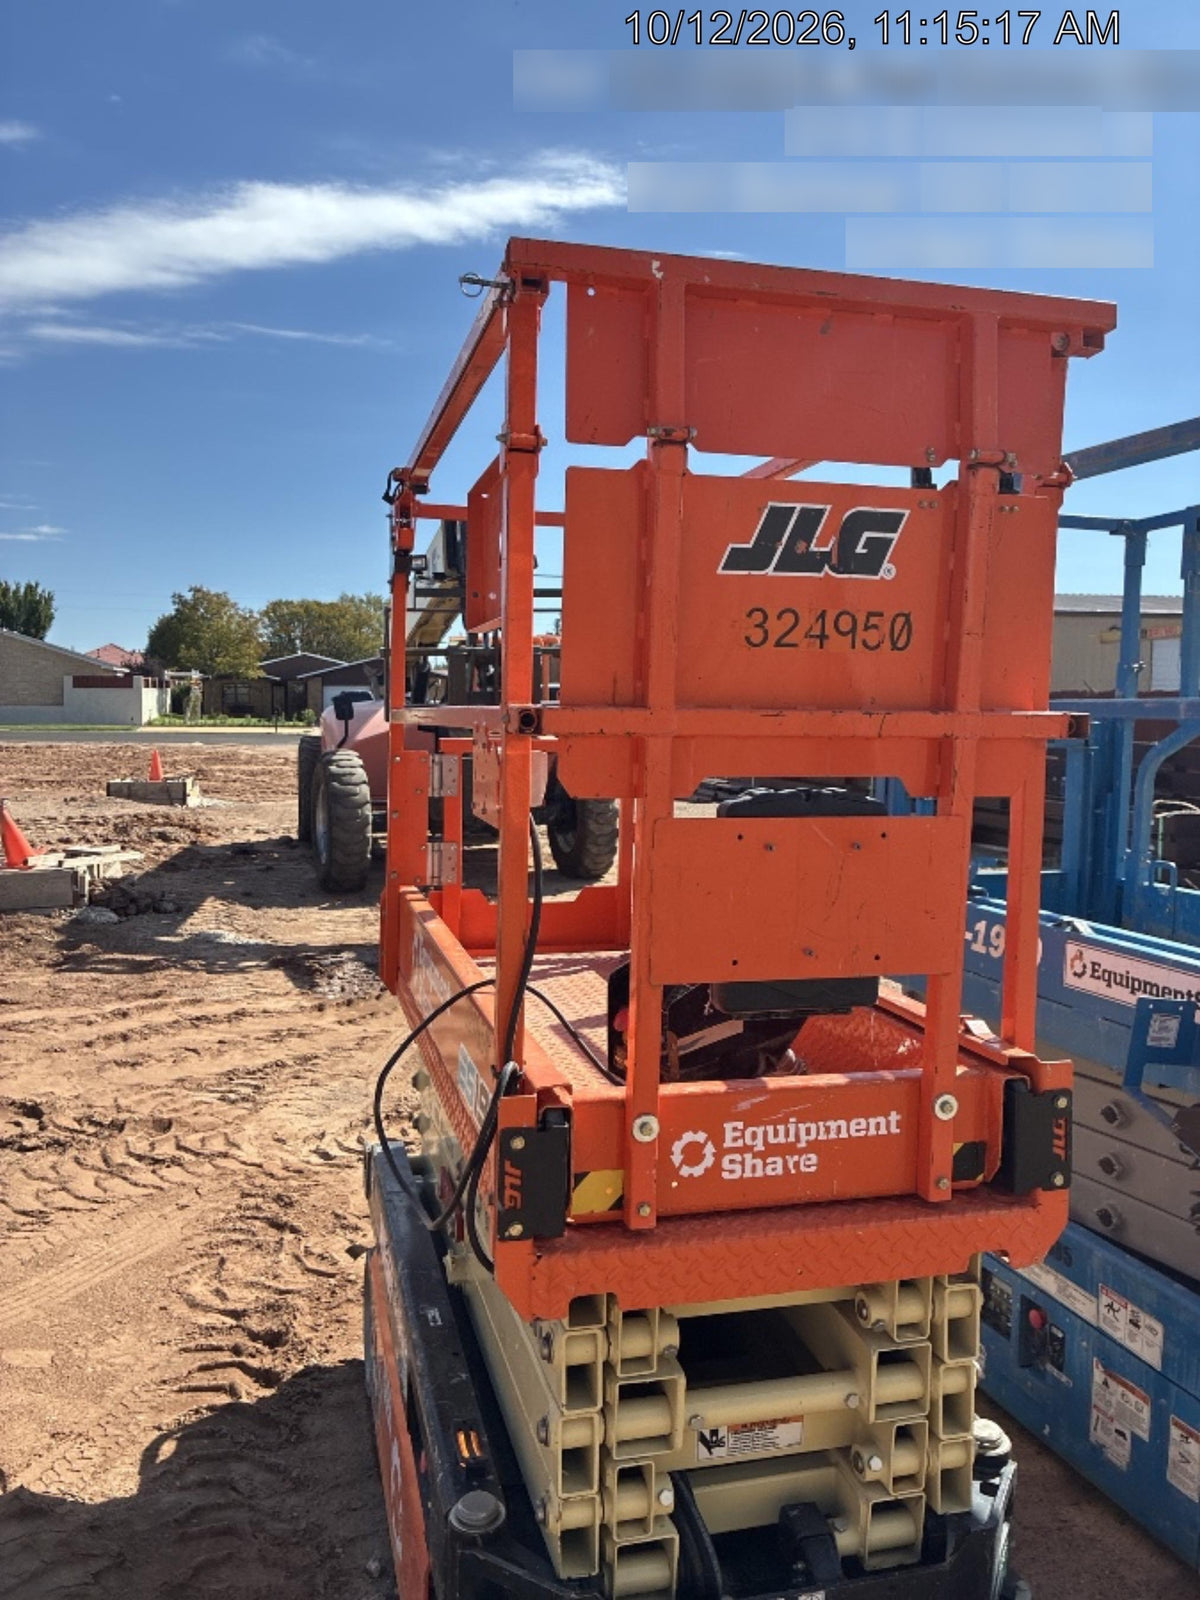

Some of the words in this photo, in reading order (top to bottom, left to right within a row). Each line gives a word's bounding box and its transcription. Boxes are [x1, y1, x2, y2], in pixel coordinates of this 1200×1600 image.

[717, 502, 910, 579] JLG
[744, 607, 913, 651] 324950
[723, 1111, 901, 1151] Equipment
[504, 1159, 522, 1210] JLG
[721, 1153, 818, 1180] Share
